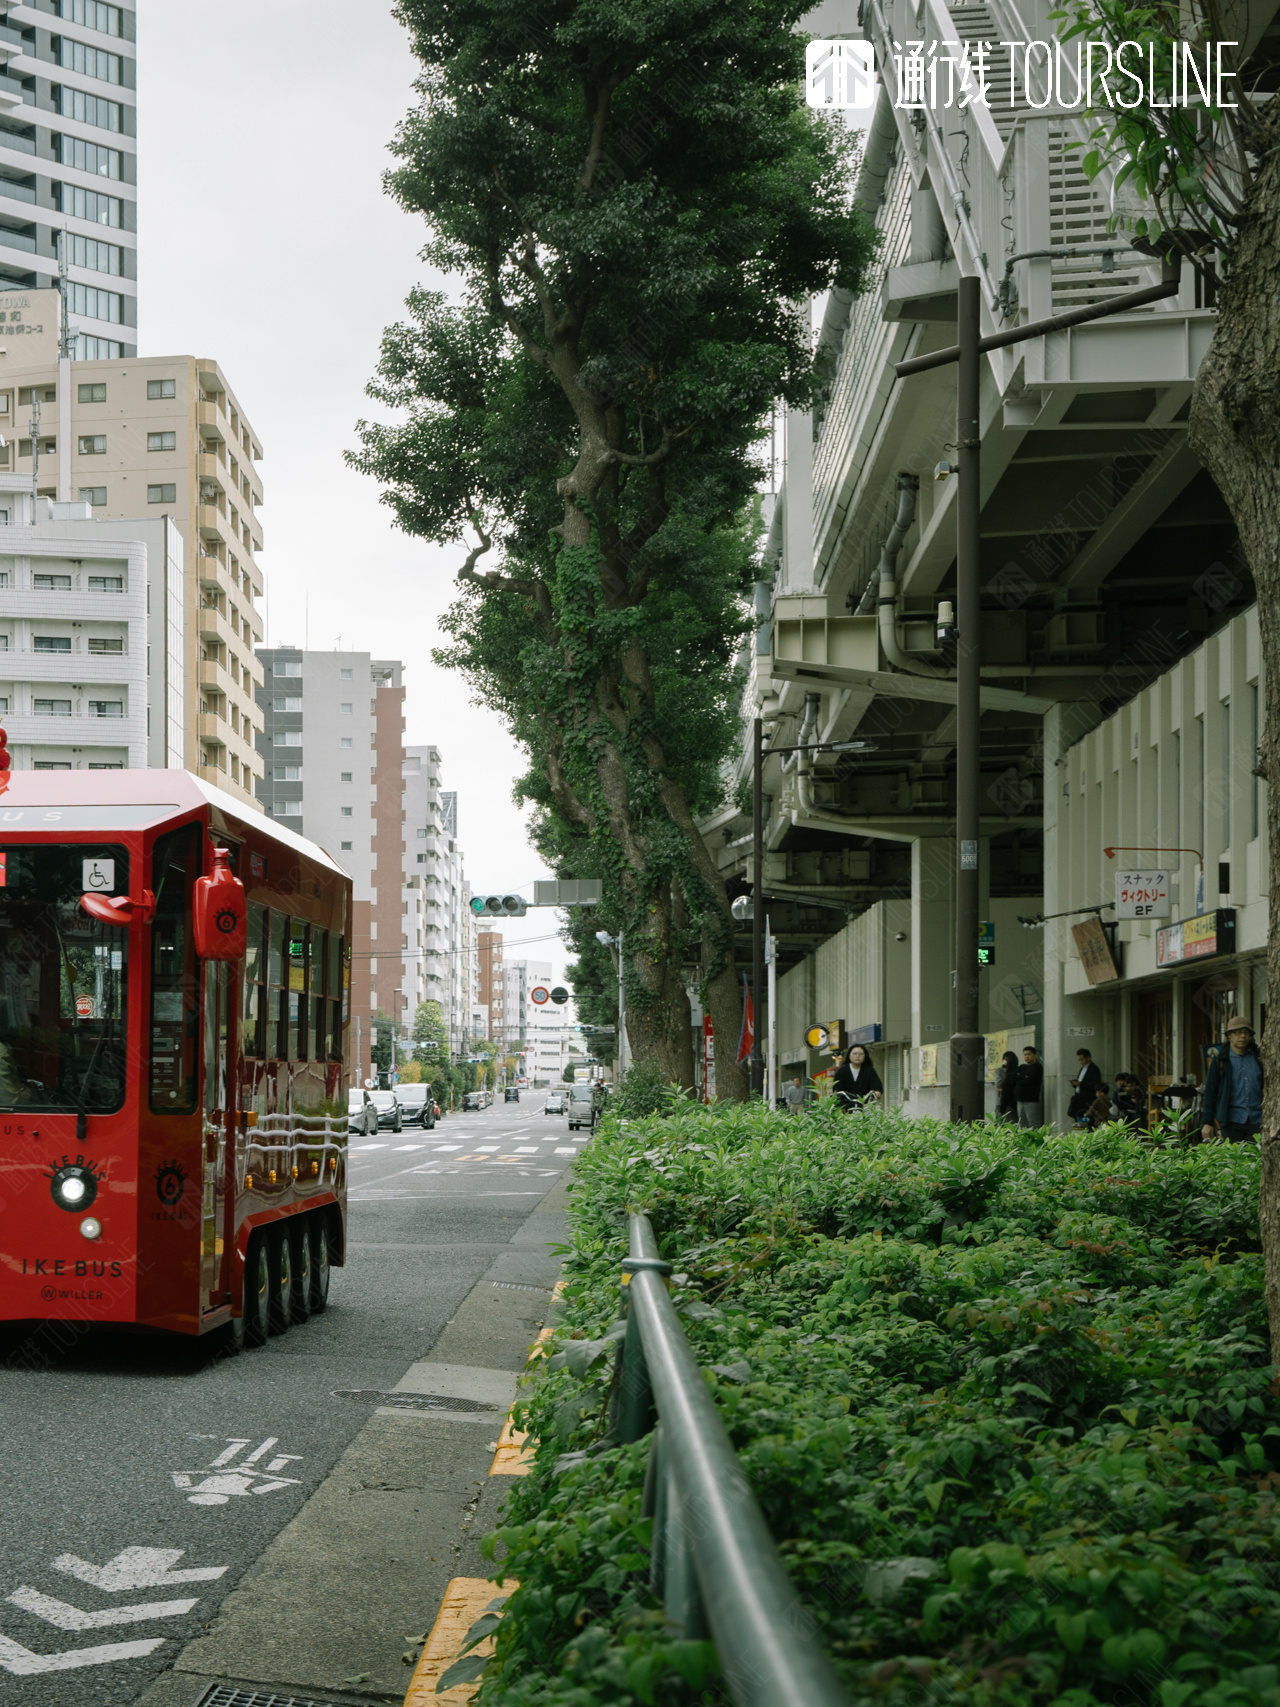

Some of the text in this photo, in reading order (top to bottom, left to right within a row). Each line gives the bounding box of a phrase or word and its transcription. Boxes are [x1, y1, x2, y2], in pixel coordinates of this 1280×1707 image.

[1123, 873, 1164, 885] スナック
[1121, 889, 1166, 903] ヴィクトリー
[1135, 905, 1153, 915] 2F
[222, 916, 231, 928] 6
[534, 991, 545, 1000] 50
[165, 1176, 176, 1196] 6
[59, 1290, 103, 1300] WILLER
